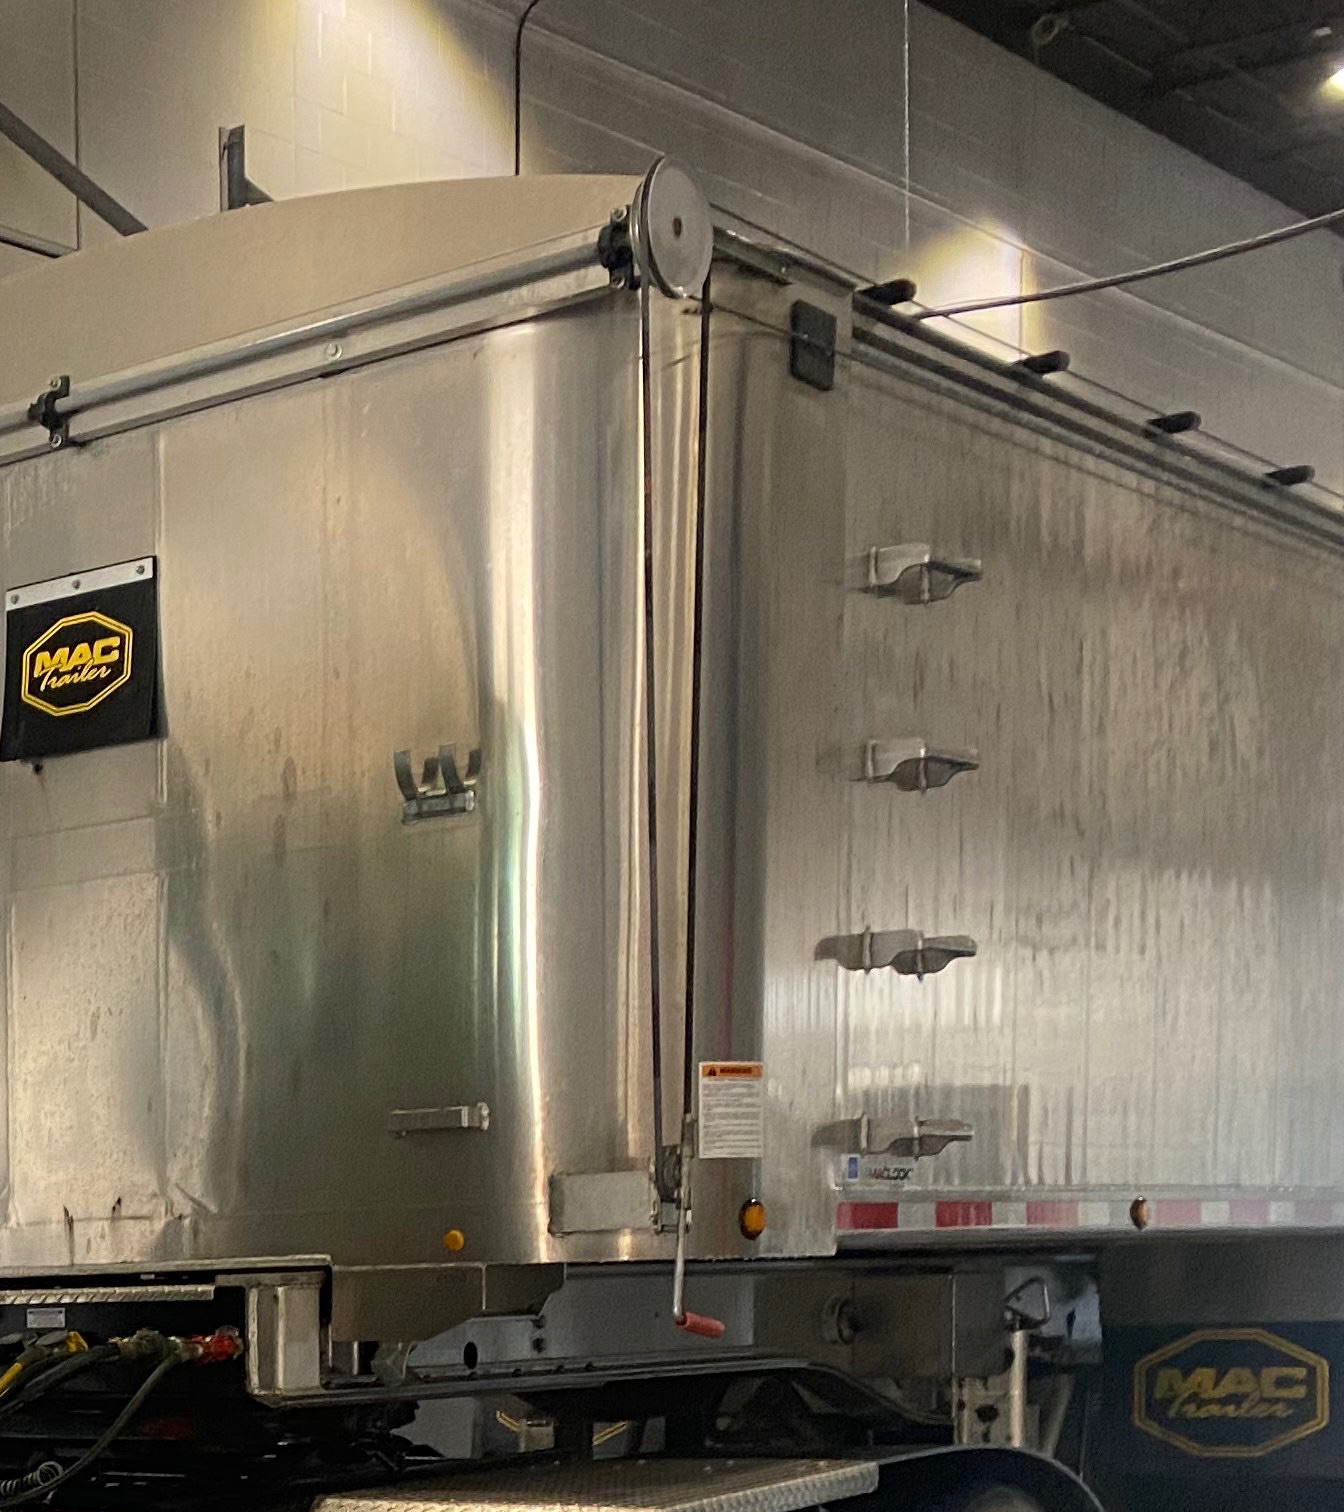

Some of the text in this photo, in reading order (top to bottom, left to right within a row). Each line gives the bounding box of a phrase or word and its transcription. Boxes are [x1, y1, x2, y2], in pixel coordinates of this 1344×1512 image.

[33, 636, 121, 678] MAC
[36, 660, 112, 692] Trailer
[1154, 1366, 1307, 1399] MAC
[1165, 1388, 1295, 1419] Trailer
